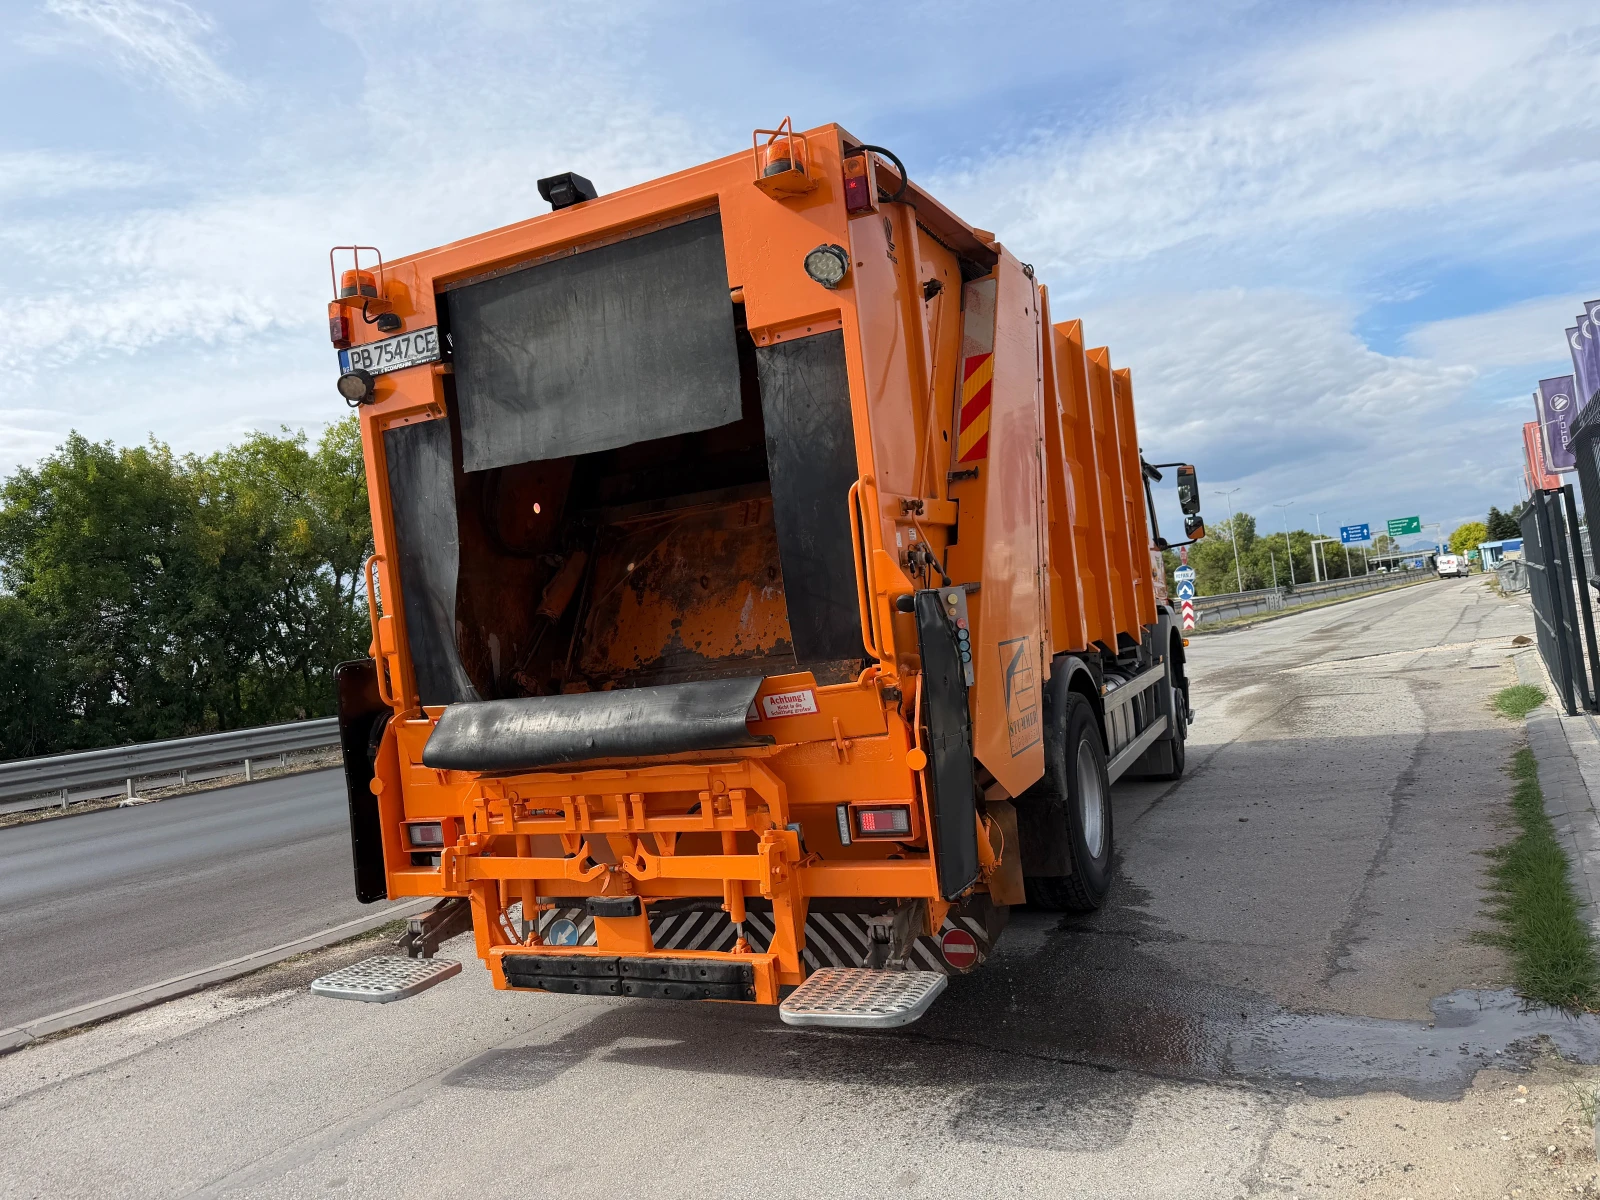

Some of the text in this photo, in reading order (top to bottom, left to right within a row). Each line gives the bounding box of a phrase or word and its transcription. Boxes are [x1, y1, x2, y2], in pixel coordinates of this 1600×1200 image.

[374, 337, 411, 366] 7547
[414, 332, 435, 355] CE
[770, 692, 806, 705] Achtung!
[1009, 710, 1038, 737] STUMMER
